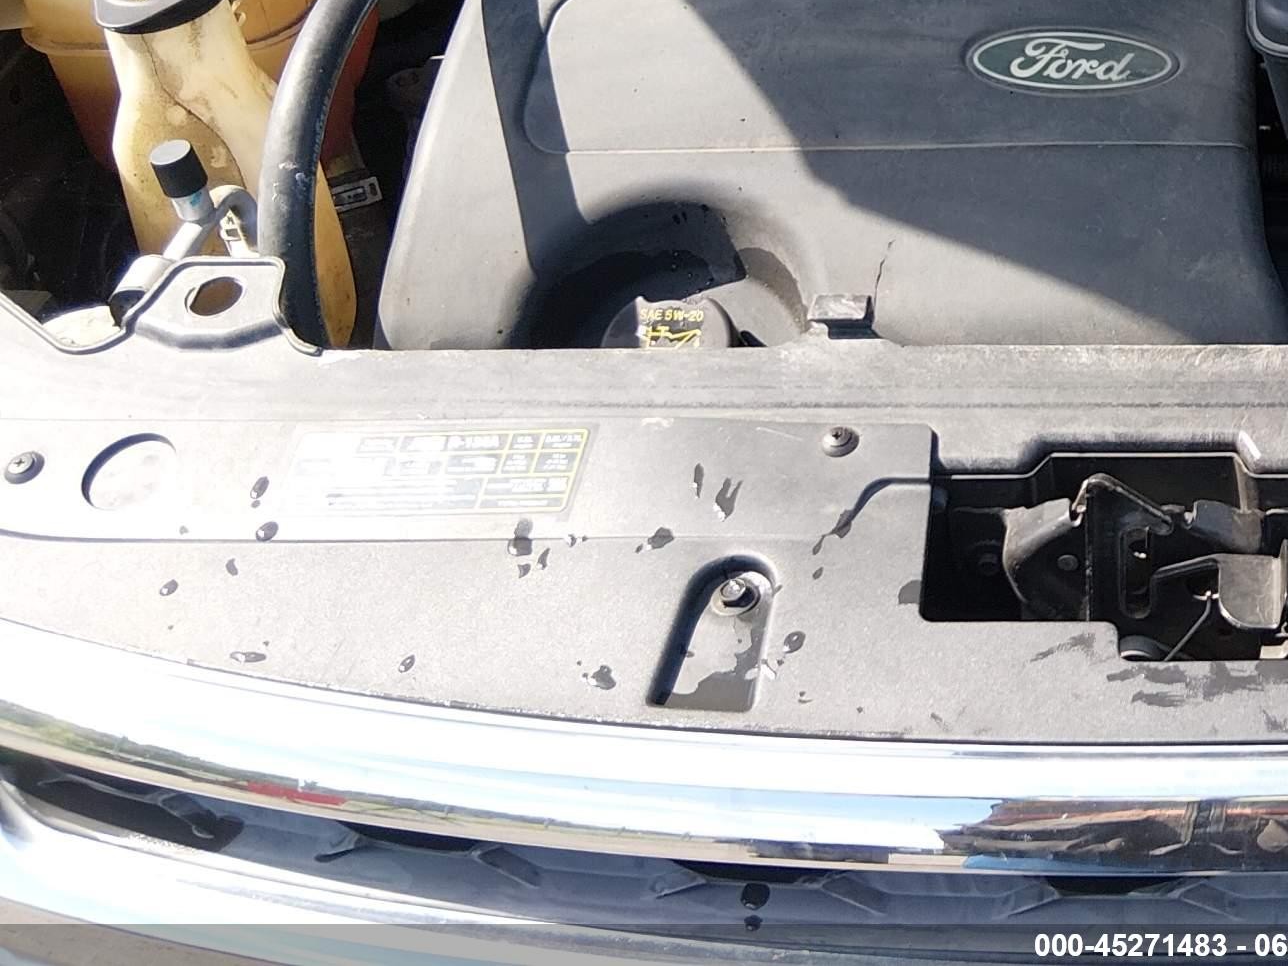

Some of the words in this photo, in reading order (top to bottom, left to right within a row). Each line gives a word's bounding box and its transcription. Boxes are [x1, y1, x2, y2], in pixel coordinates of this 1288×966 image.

[1010, 38, 1135, 81] Ford
[640, 308, 663, 321] SAE
[665, 308, 704, 322] 5W-20
